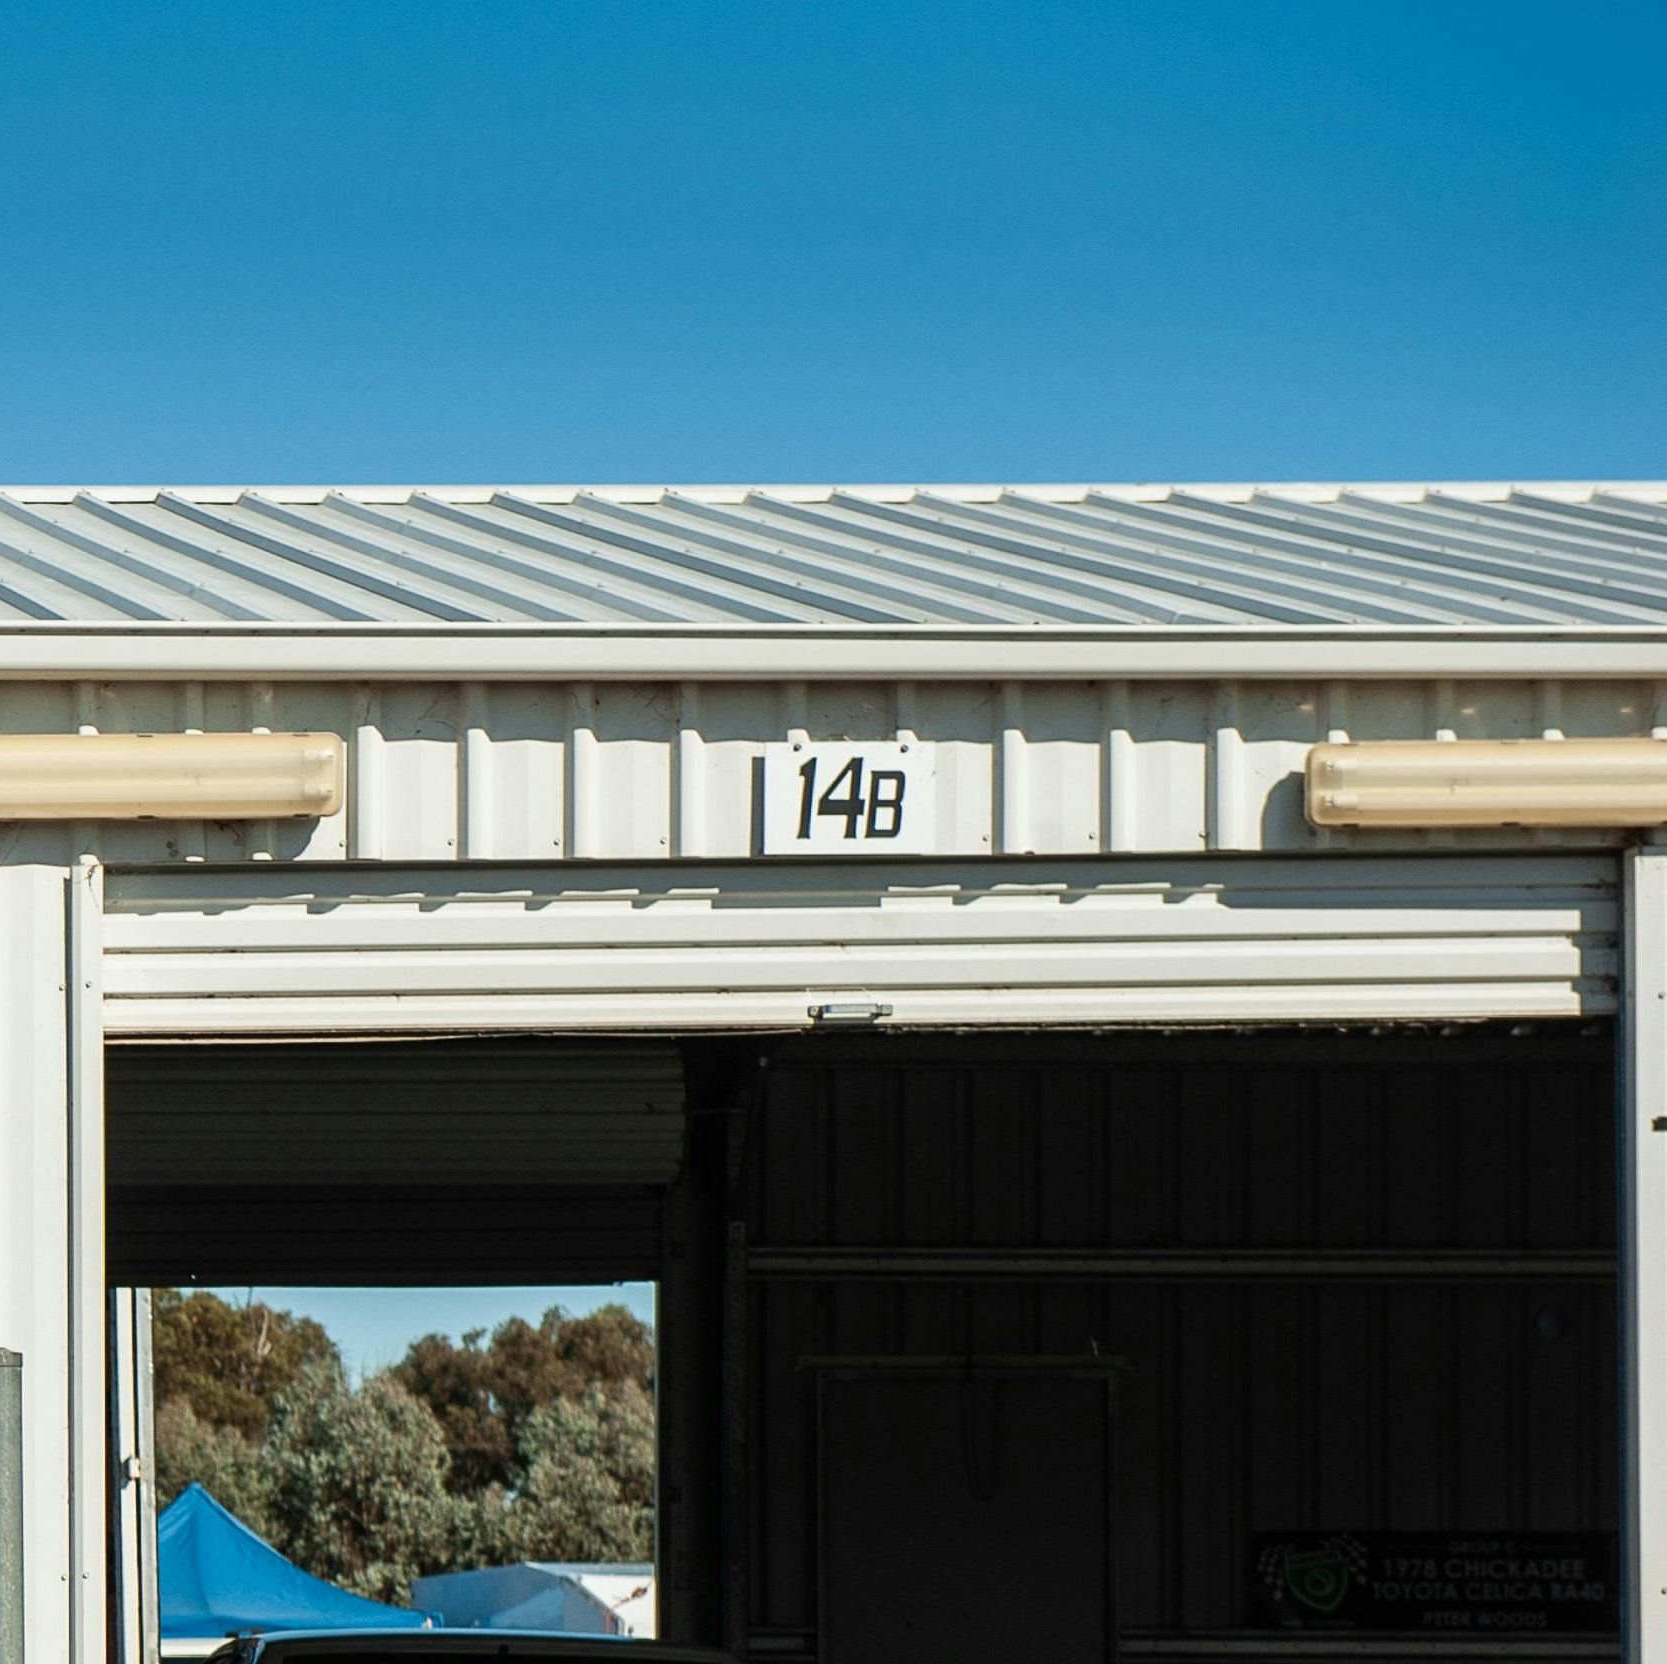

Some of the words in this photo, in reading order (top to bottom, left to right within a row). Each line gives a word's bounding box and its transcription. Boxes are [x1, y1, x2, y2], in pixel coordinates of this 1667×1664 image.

[796, 756, 906, 840] 14B
[1382, 1558, 1437, 1579] 1978
[1443, 1558, 1585, 1579] CHICKADEE
[1371, 1582, 1457, 1601] TOYOTA
[1464, 1582, 1544, 1602] CELICA
[1422, 1611, 1471, 1627] PETER
[1477, 1611, 1548, 1628] WOODS
